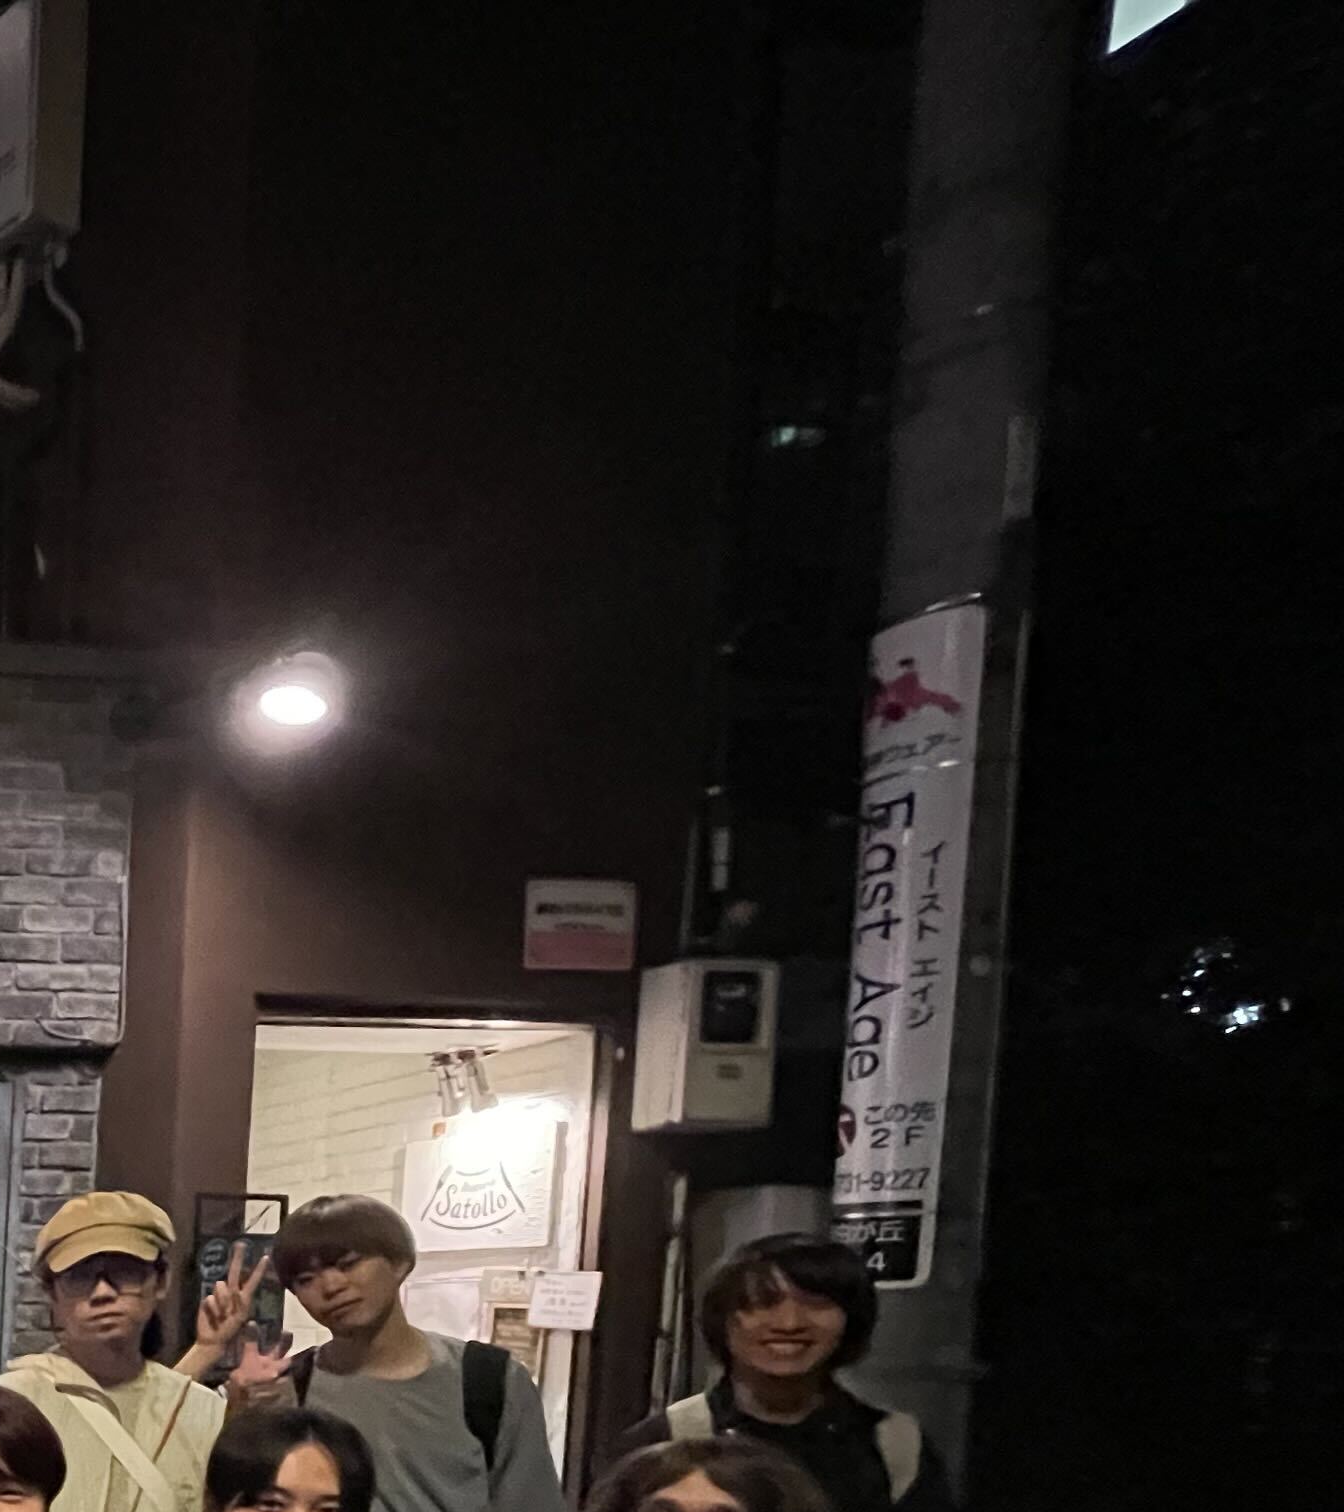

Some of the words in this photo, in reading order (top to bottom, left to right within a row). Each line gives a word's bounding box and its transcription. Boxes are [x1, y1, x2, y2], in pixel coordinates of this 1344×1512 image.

[857, 791, 917, 943] East
[863, 1101, 937, 1125] この先
[435, 1183, 508, 1219] Satollo
